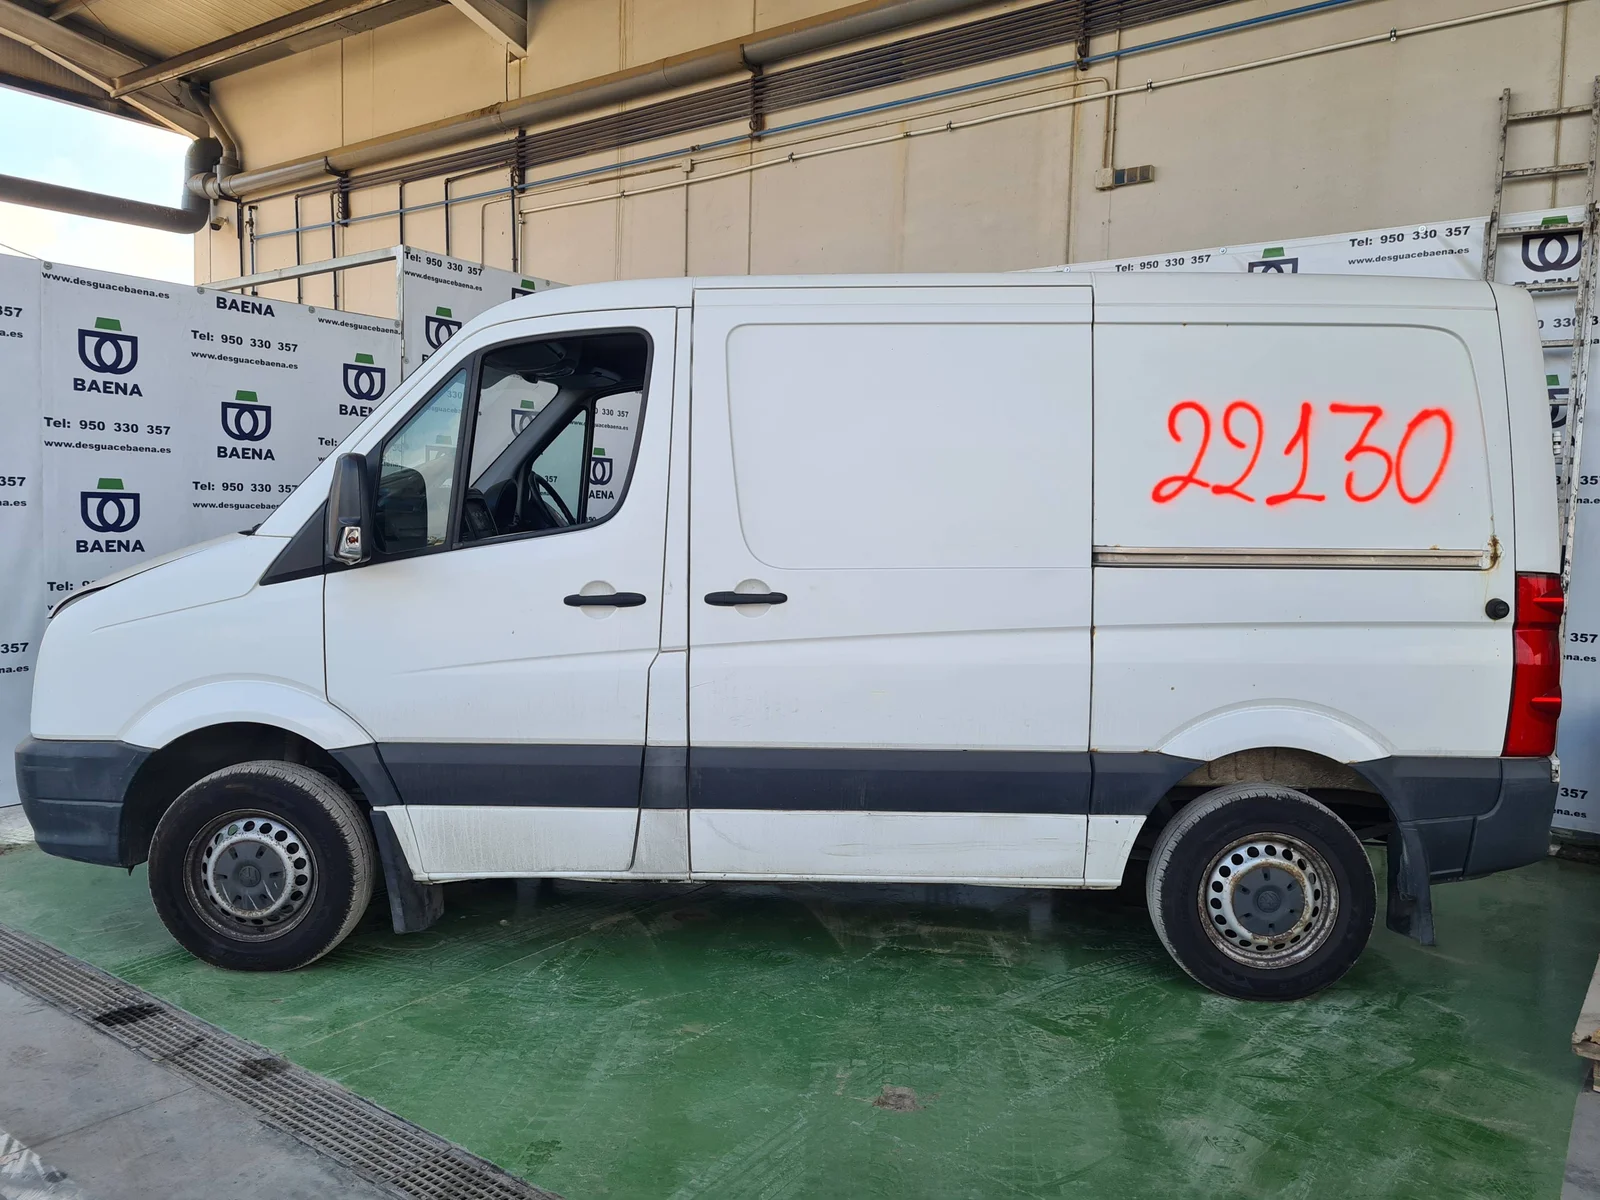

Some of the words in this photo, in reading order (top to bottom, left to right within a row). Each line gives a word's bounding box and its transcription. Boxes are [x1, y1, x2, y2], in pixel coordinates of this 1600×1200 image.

[1349, 237, 1373, 248] Tel:
[1380, 232, 1405, 244] 950
[1412, 229, 1438, 241] 330
[1445, 225, 1471, 237] 357
[404, 251, 422, 263] Tel:
[425, 256, 443, 268] 950
[446, 261, 463, 273] 330
[467, 265, 484, 277] 357
[1115, 263, 1134, 273] Tel:
[1139, 260, 1159, 270] 950
[1164, 257, 1185, 268] 330
[1190, 254, 1212, 265] 357
[1348, 246, 1470, 265] www.desguacebaena.es
[41, 271, 170, 300] www.desguacebaena.es
[404, 269, 483, 292] www.desguacebaena.es
[216, 296, 275, 318] BAENA
[190, 329, 214, 342] Tel:
[220, 334, 243, 346] 950
[249, 338, 272, 350] 330
[277, 341, 298, 353] 357
[190, 350, 299, 370] www.desguacebaena.es
[73, 377, 143, 397] BAENA
[617, 410, 629, 418] 357
[43, 416, 71, 429] Tel:
[79, 419, 106, 431] 950
[113, 422, 139, 434] 330
[146, 424, 171, 436] 357
[43, 440, 172, 454] www.desguacebaena.es
[317, 436, 338, 447] Tel:
[217, 445, 276, 461] BAENA
[1151, 400, 1454, 506] 22130
[192, 481, 215, 491] Tel:
[221, 482, 244, 492] 950
[250, 483, 272, 493] 330
[1580, 475, 1600, 486] 35
[588, 490, 615, 500] AENA
[75, 539, 146, 553] BAENA
[46, 581, 74, 592] Tel:
[1569, 632, 1599, 644] 357
[0, 642, 29, 654] 357
[1560, 787, 1589, 800] 357
